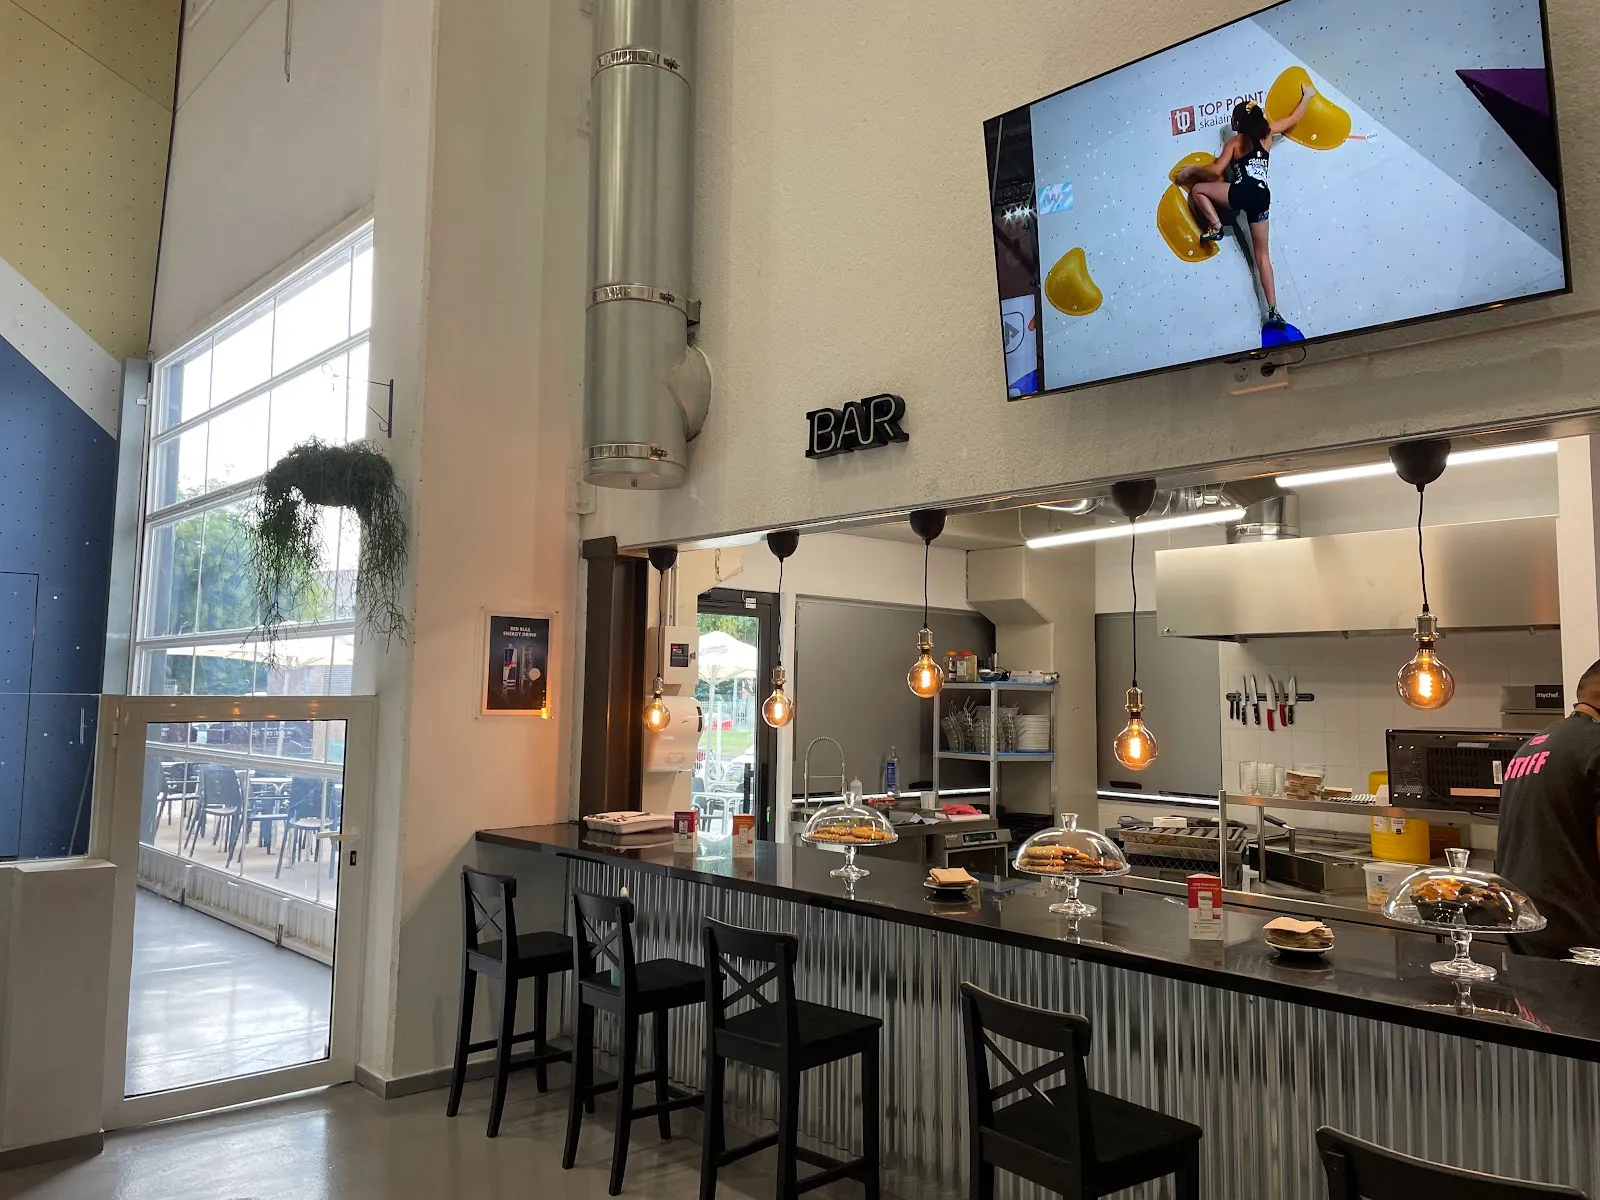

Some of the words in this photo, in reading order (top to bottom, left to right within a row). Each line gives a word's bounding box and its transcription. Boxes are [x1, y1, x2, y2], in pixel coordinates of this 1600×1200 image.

[1198, 101, 1223, 117] TOP
[1226, 90, 1264, 111] POINT
[805, 393, 909, 459] BAR
[1536, 691, 1559, 699] mychef
